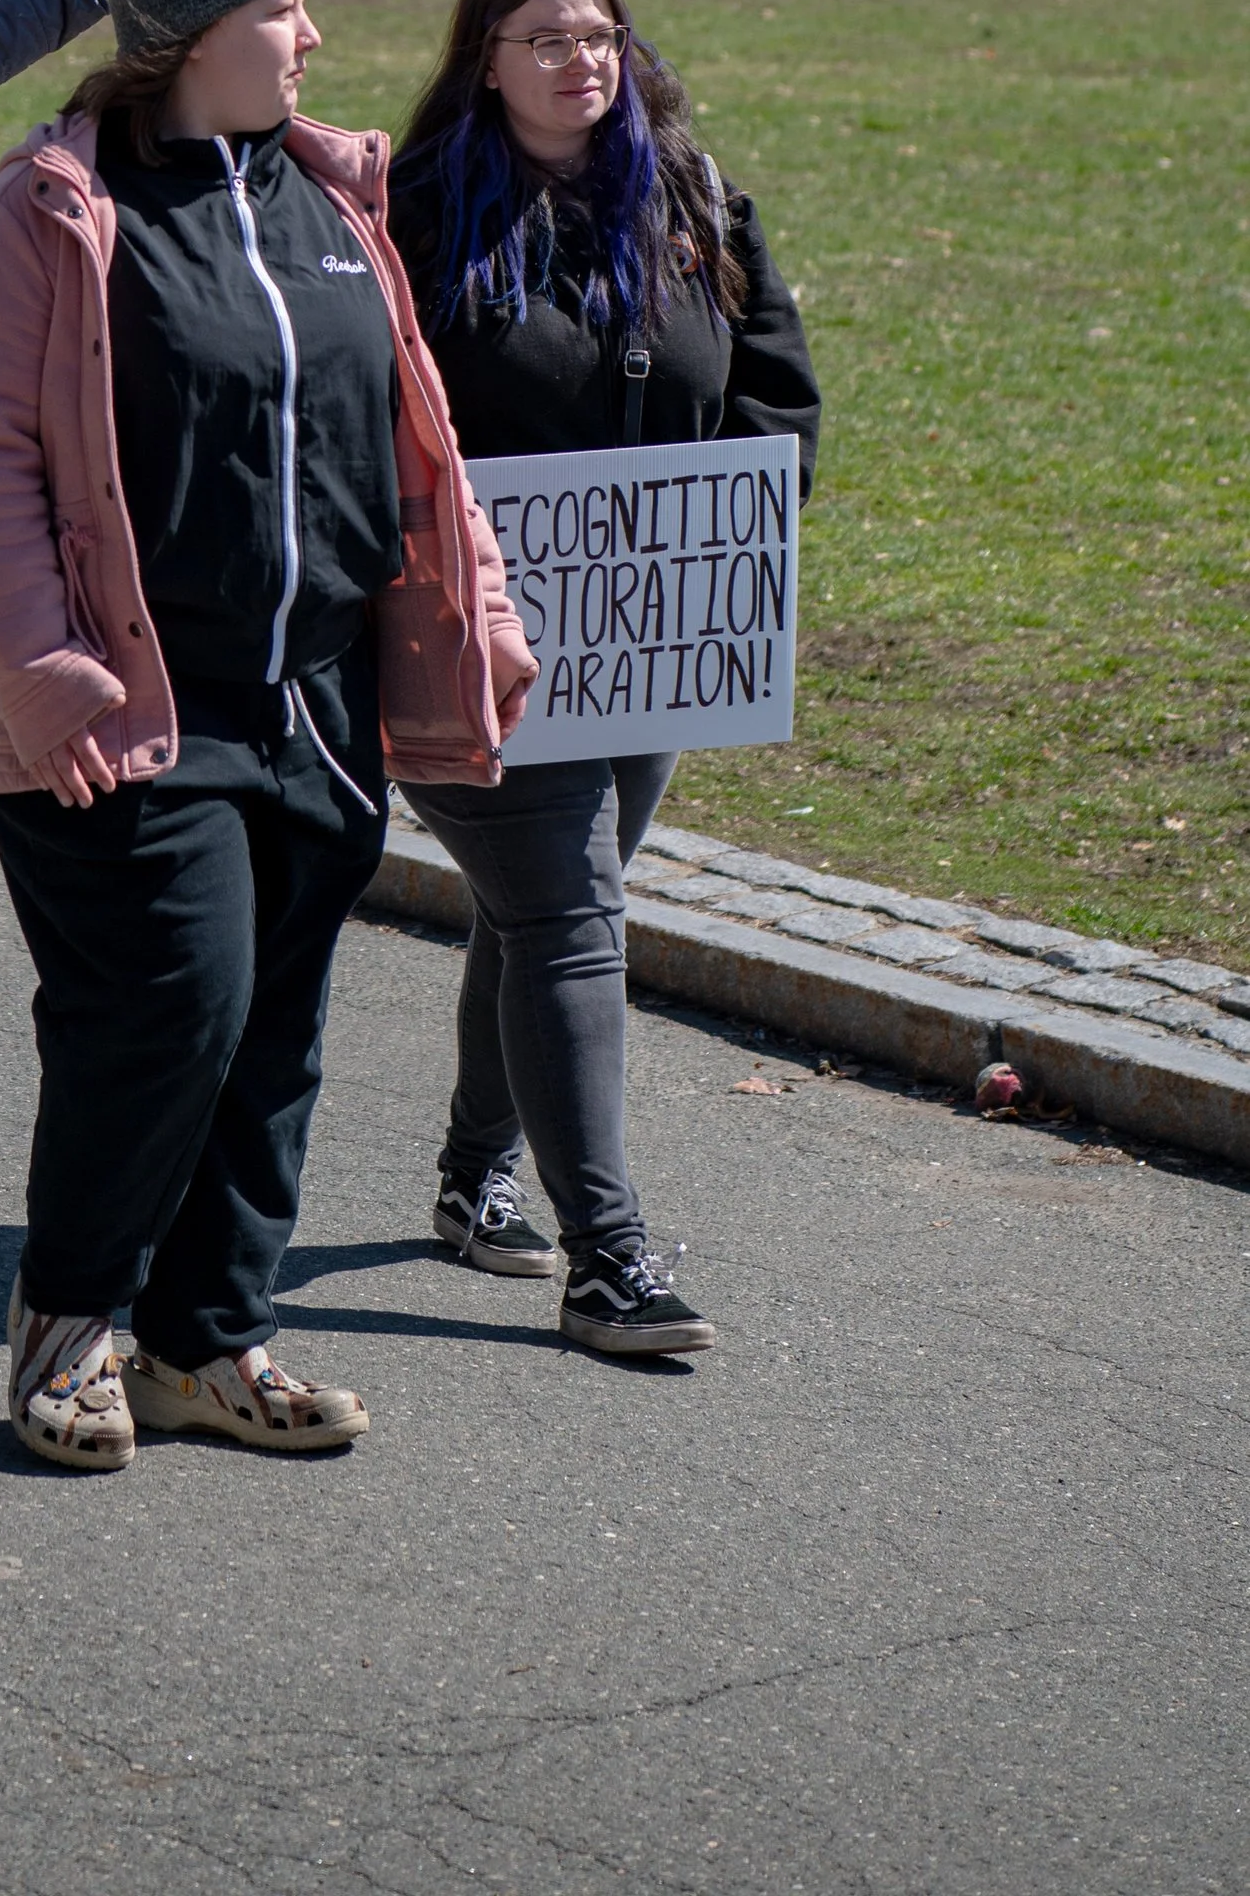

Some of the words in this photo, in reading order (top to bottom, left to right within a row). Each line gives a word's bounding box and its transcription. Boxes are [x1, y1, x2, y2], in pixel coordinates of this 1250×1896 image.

[474, 469, 787, 565] ECOGNITION
[507, 549, 786, 648] STORATION
[538, 638, 772, 717] ARATION!
